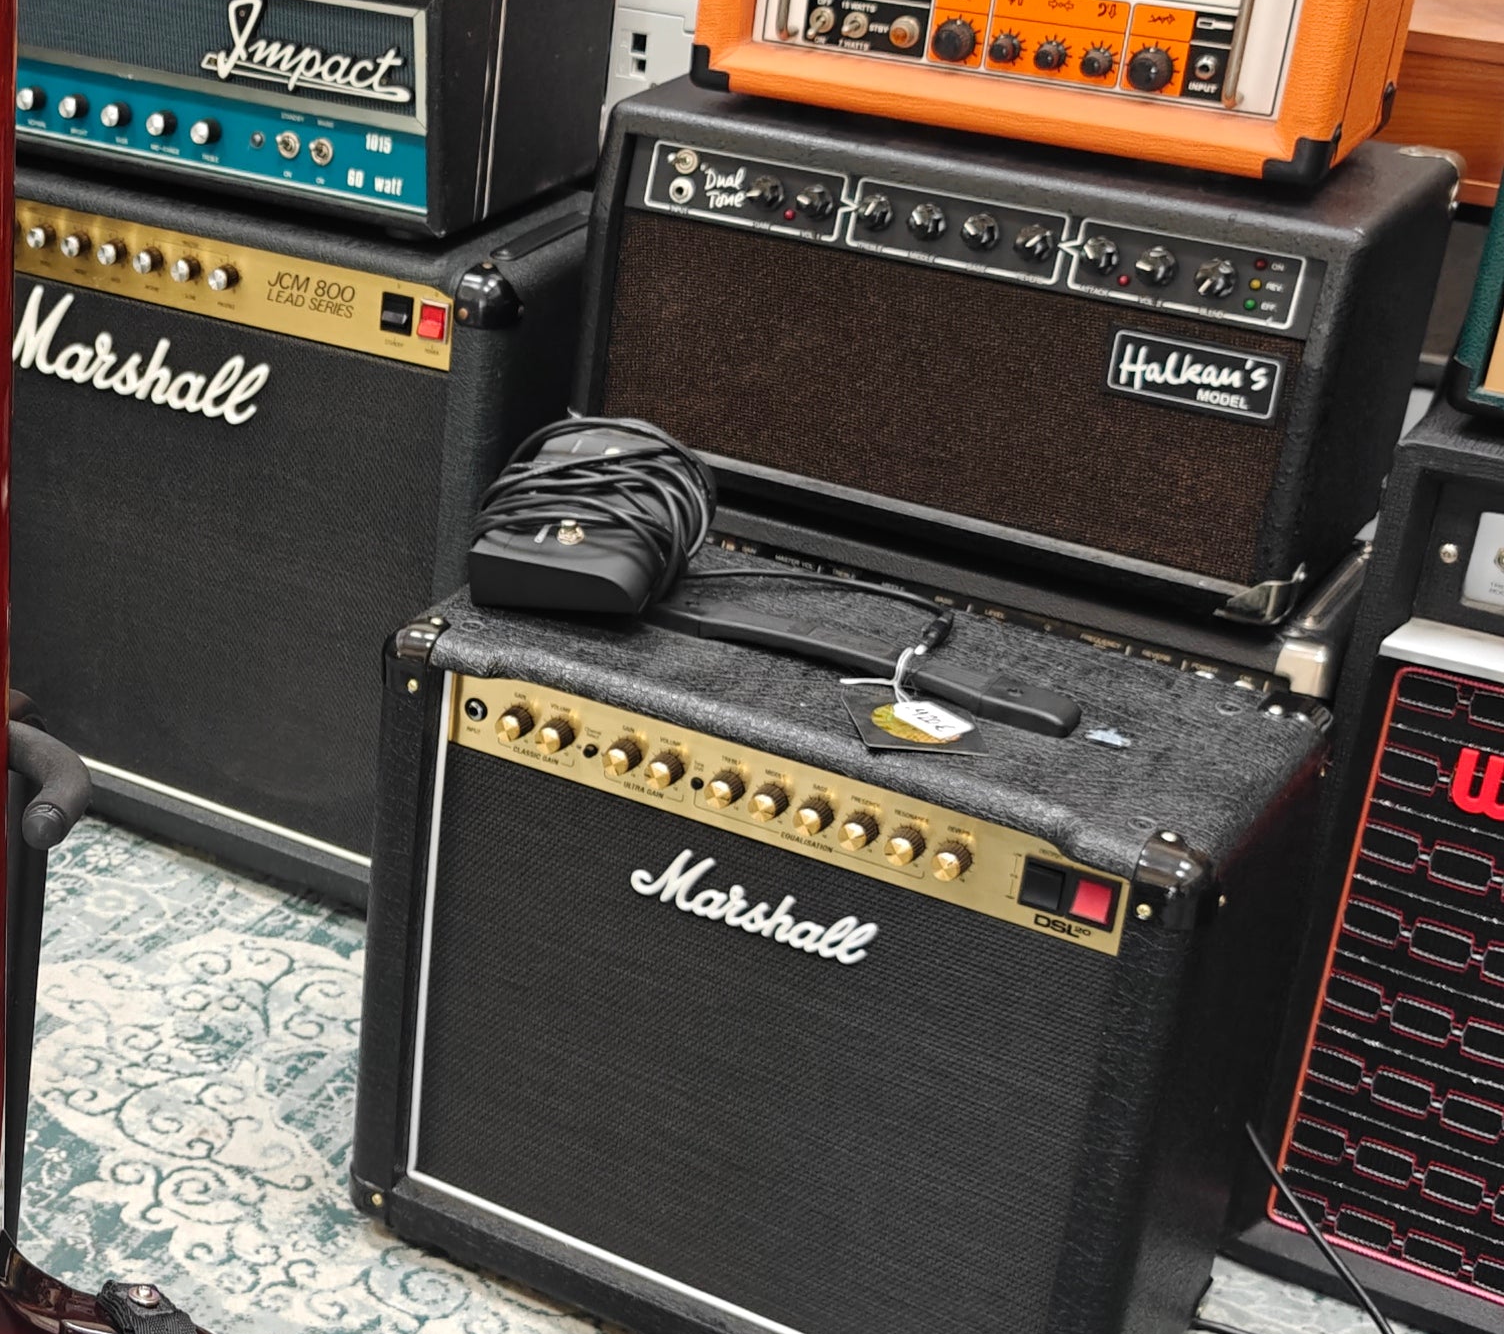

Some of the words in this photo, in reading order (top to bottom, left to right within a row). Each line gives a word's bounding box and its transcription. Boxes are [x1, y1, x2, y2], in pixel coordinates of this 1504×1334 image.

[1188, 80, 1217, 93] INPUT
[364, 133, 393, 155] 1015
[347, 168, 365, 189] 60
[374, 176, 404, 197] watt
[704, 166, 746, 191] Dual
[706, 191, 746, 209] Tone
[267, 271, 311, 294] JCM
[314, 280, 356, 303] 800
[266, 288, 306, 308] LEAD
[308, 298, 355, 319] SERIES
[12, 284, 270, 425] Marshall
[1118, 342, 1269, 391] Halkan's
[1195, 388, 1249, 410] MODEL
[512, 744, 542, 762] CLASSIC
[541, 753, 560, 766] GAIN
[623, 779, 646, 795] ULTRA
[645, 786, 666, 800] GAIN
[779, 830, 835, 854] EQUALISATION
[629, 847, 880, 966] Marshall
